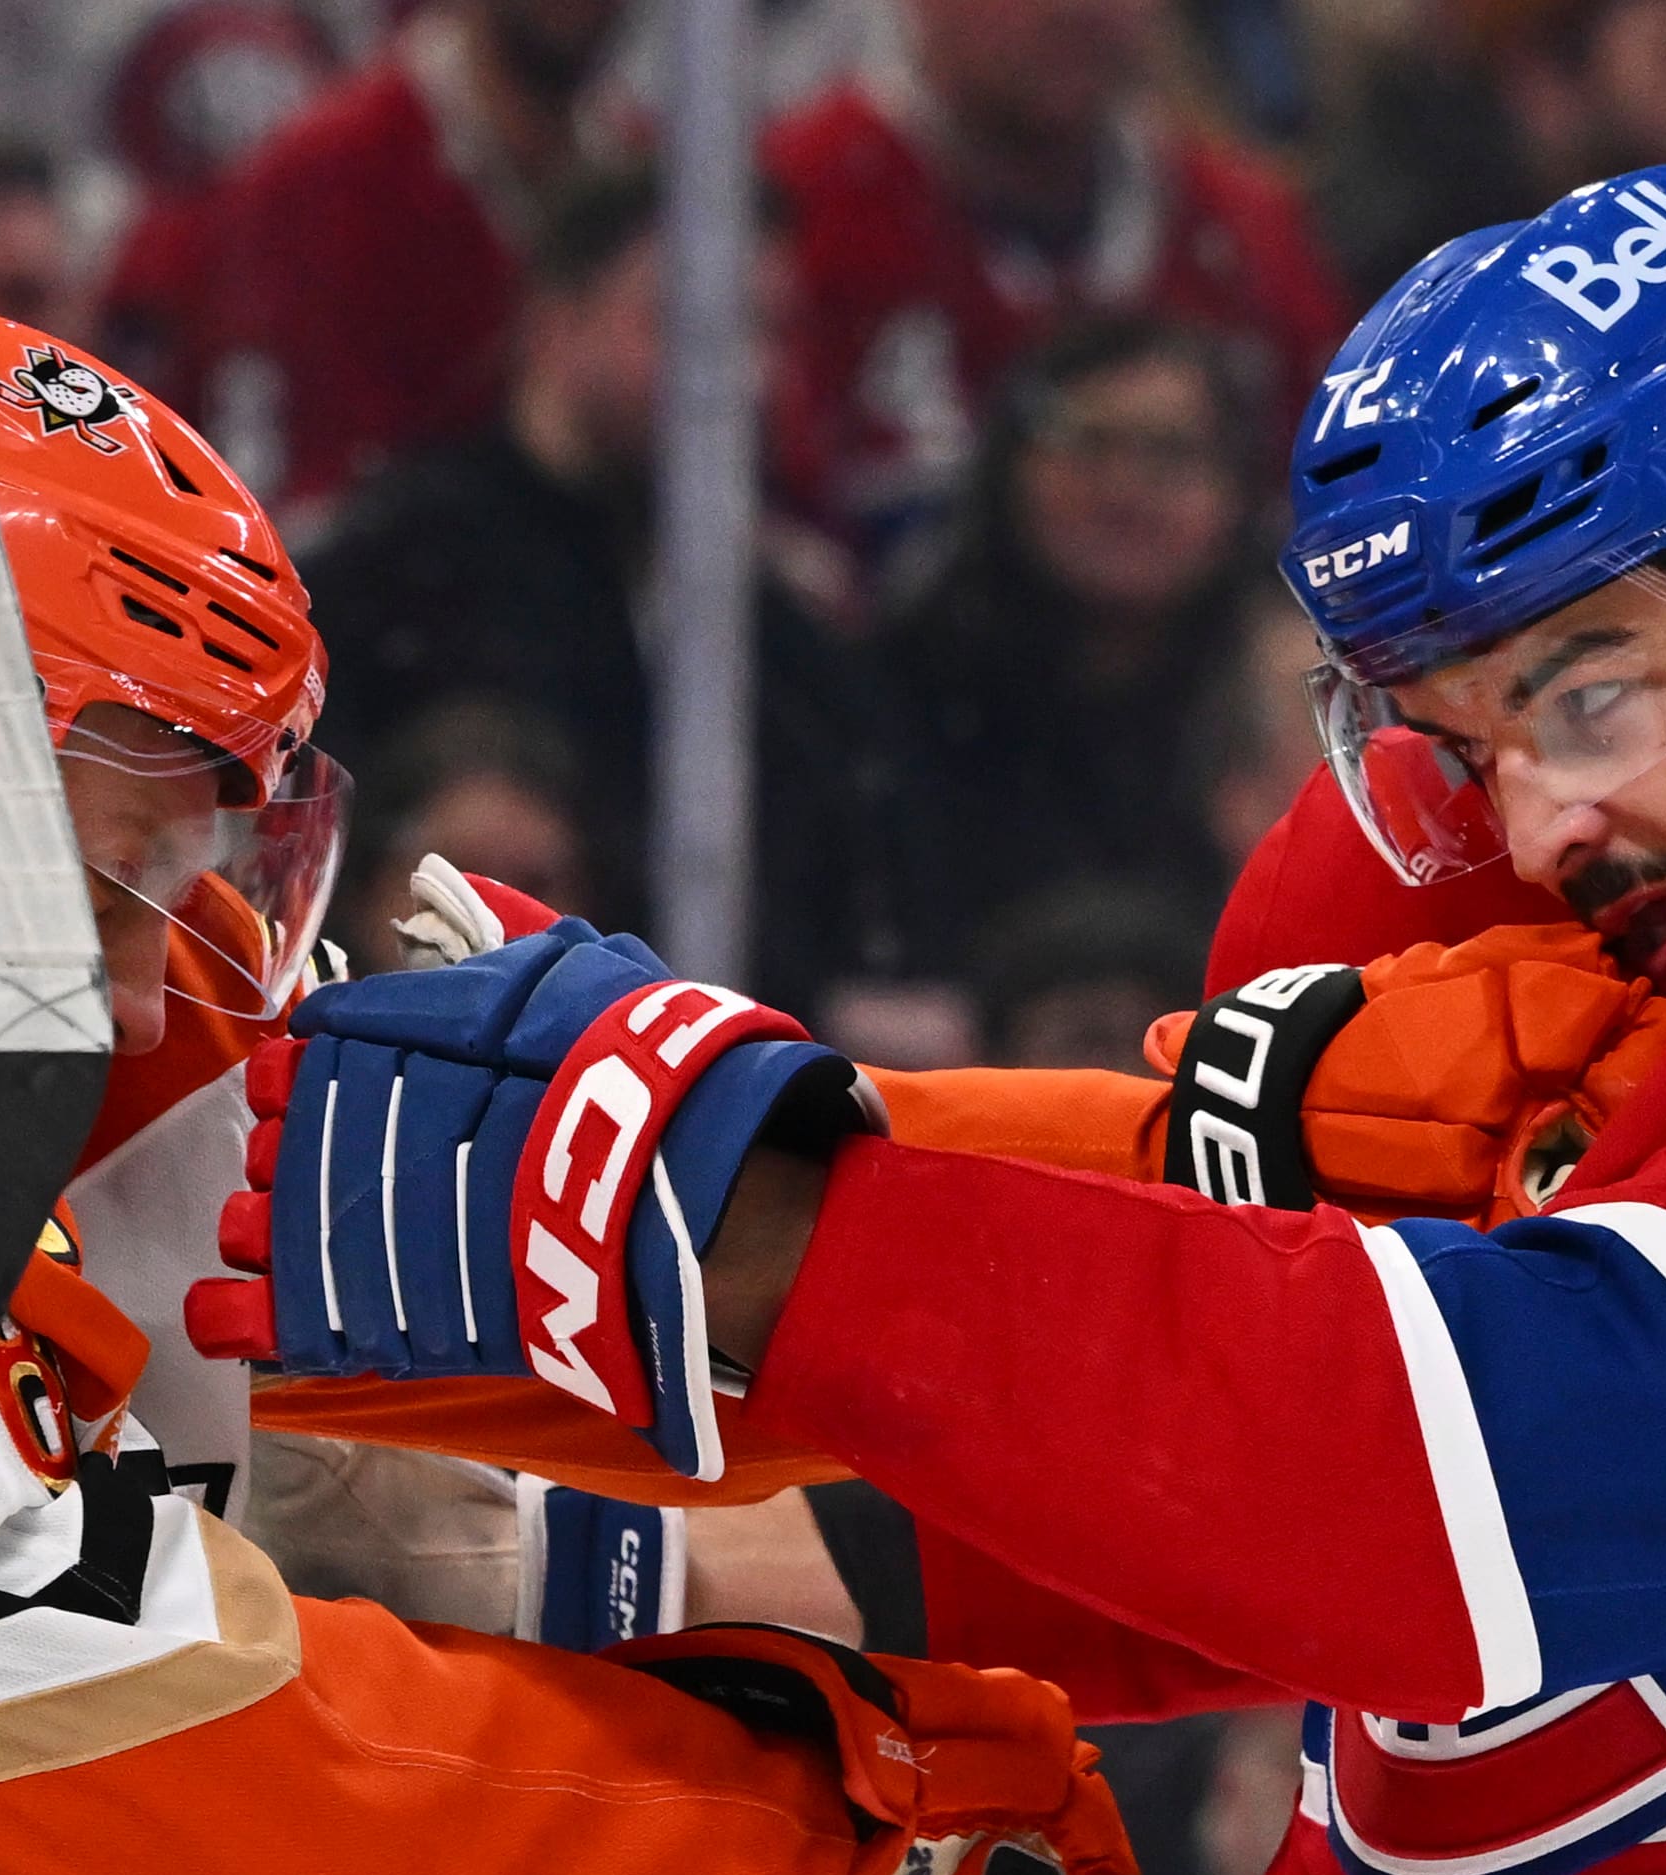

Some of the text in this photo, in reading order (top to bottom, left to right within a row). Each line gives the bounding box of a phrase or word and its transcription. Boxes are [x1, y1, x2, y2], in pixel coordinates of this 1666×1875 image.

[1313, 356, 1396, 443] 72
[1303, 520, 1412, 589] CCM
[524, 980, 758, 1418] CCM
[619, 1528, 640, 1640] CCM
